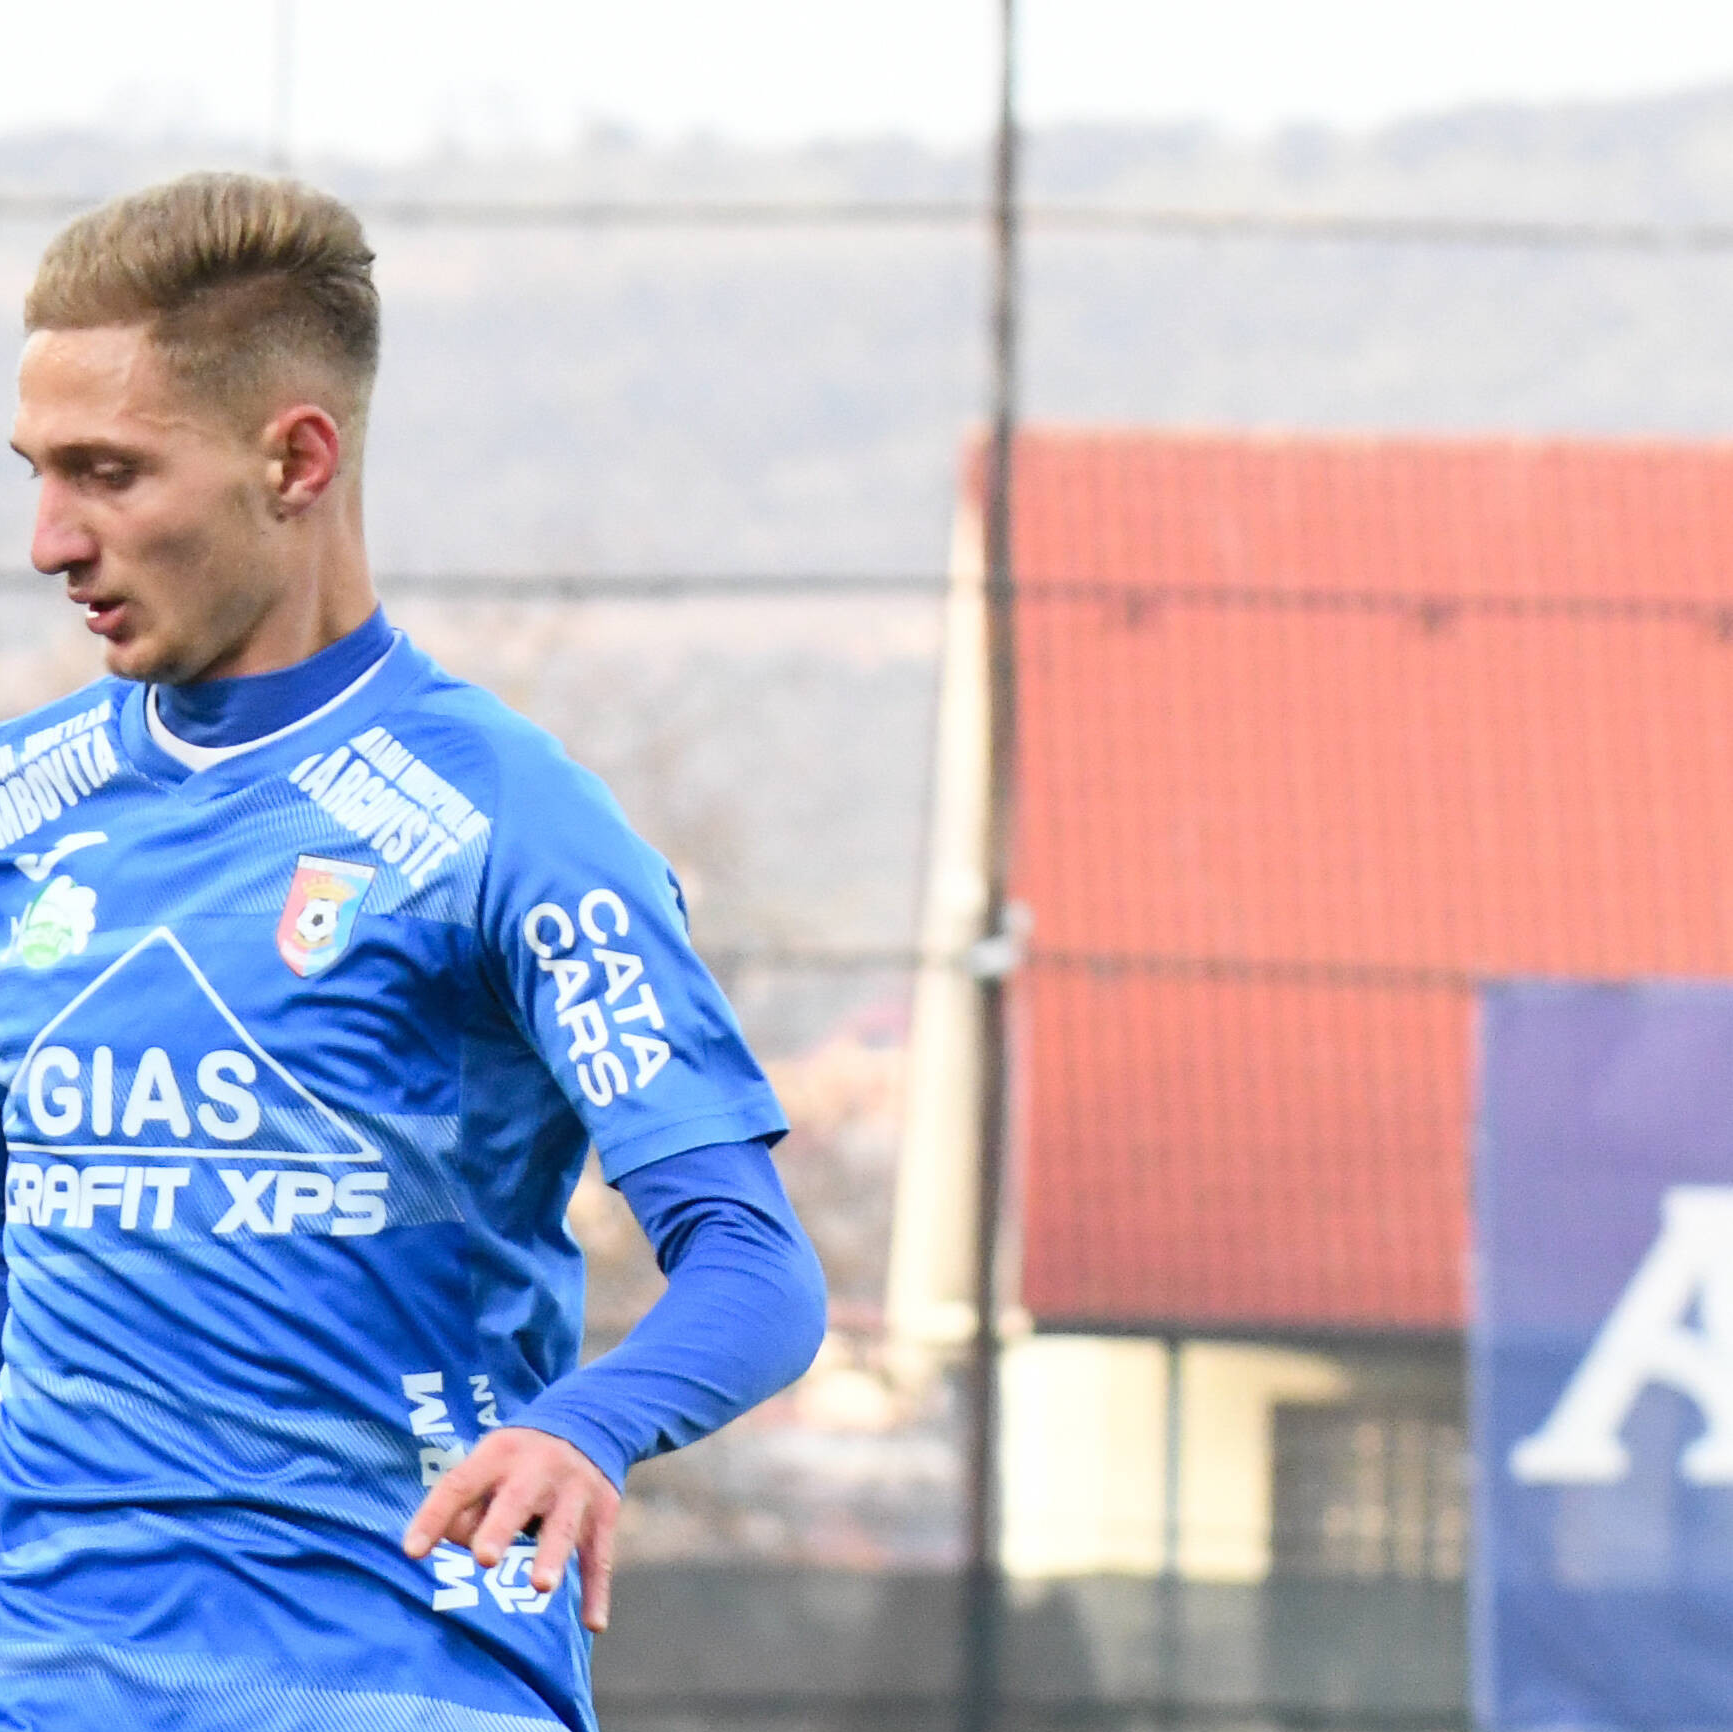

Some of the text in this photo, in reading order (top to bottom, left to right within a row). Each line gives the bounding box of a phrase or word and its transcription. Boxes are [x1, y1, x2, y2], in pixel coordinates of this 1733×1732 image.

[524, 902, 629, 1107] CARS
[578, 888, 671, 1089] CATA
[28, 1046, 260, 1140] GIAS
[212, 1168, 389, 1236] XPS
